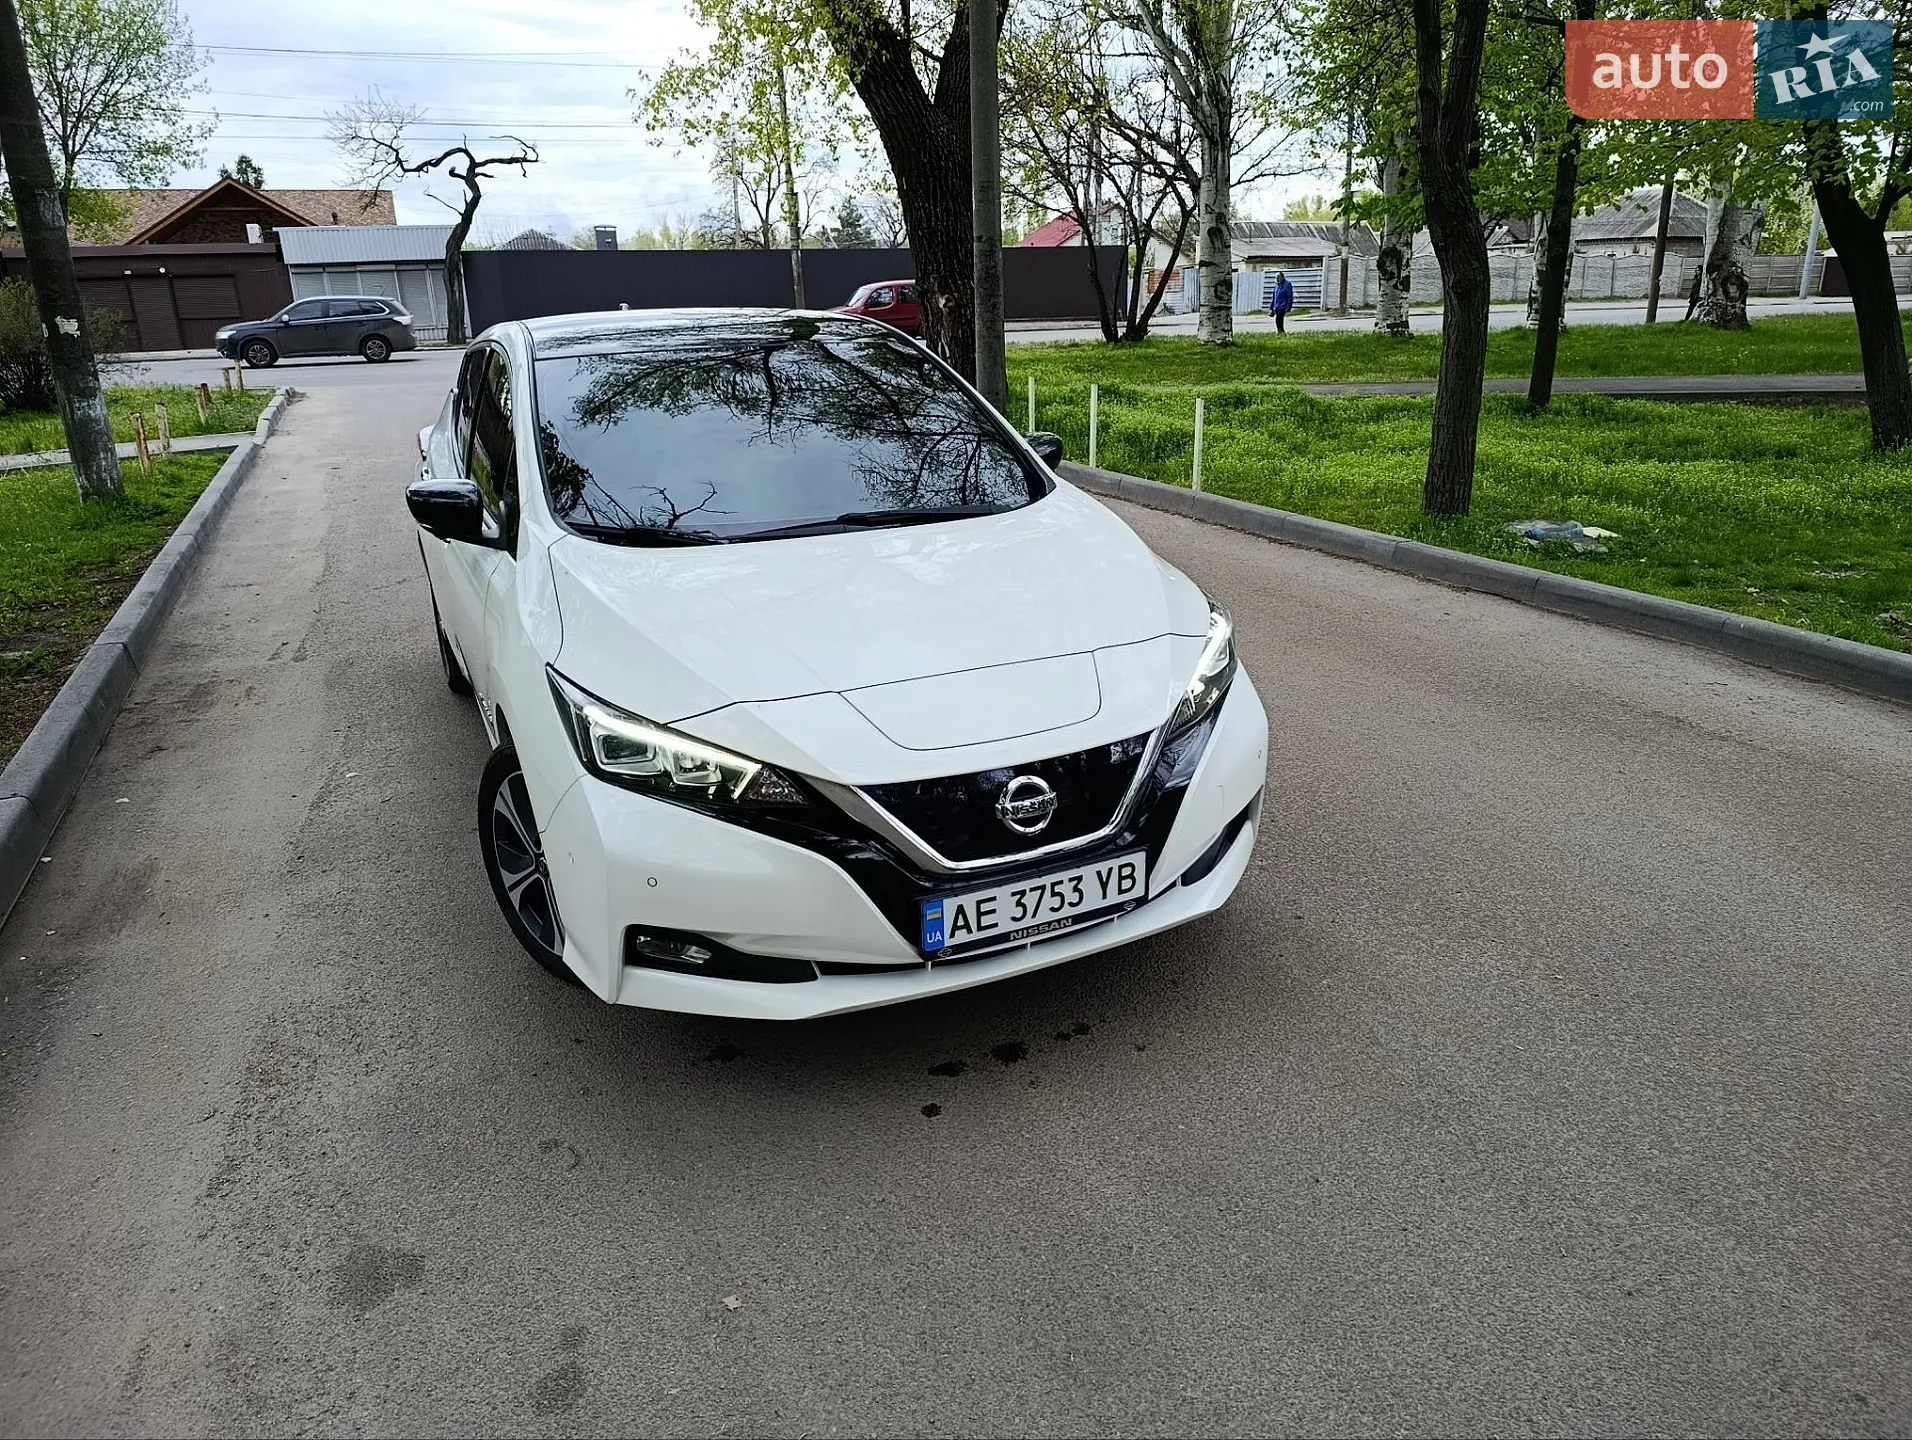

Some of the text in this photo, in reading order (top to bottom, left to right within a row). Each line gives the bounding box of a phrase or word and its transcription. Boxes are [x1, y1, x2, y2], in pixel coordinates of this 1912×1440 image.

[1003, 797, 1055, 818] NISSAN
[949, 862, 1137, 939] AE 3753 YB
[926, 931, 942, 943] UA
[1010, 918, 1073, 941] NISSAN
